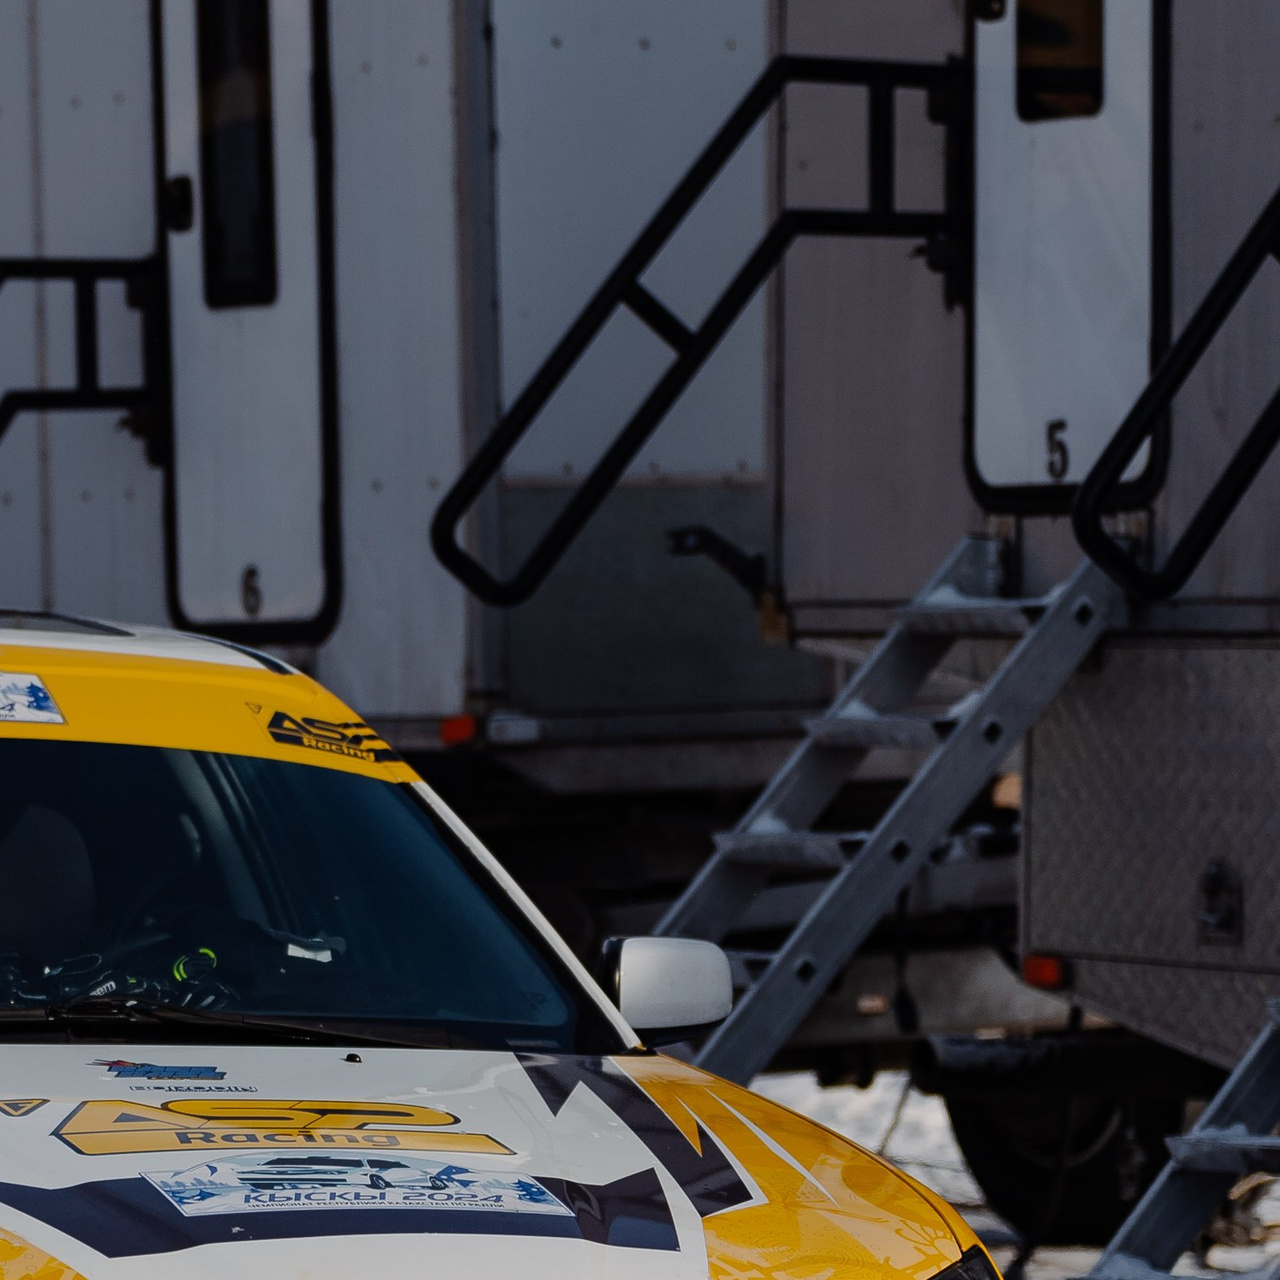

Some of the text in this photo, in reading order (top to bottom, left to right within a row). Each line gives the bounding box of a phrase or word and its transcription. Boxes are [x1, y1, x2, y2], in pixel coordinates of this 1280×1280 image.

[1047, 419, 1068, 479] 5
[302, 736, 376, 762] Racing
[53, 1098, 462, 1136] ASP
[174, 1128, 402, 1147] Racing
[402, 1192, 504, 1204] 2024
